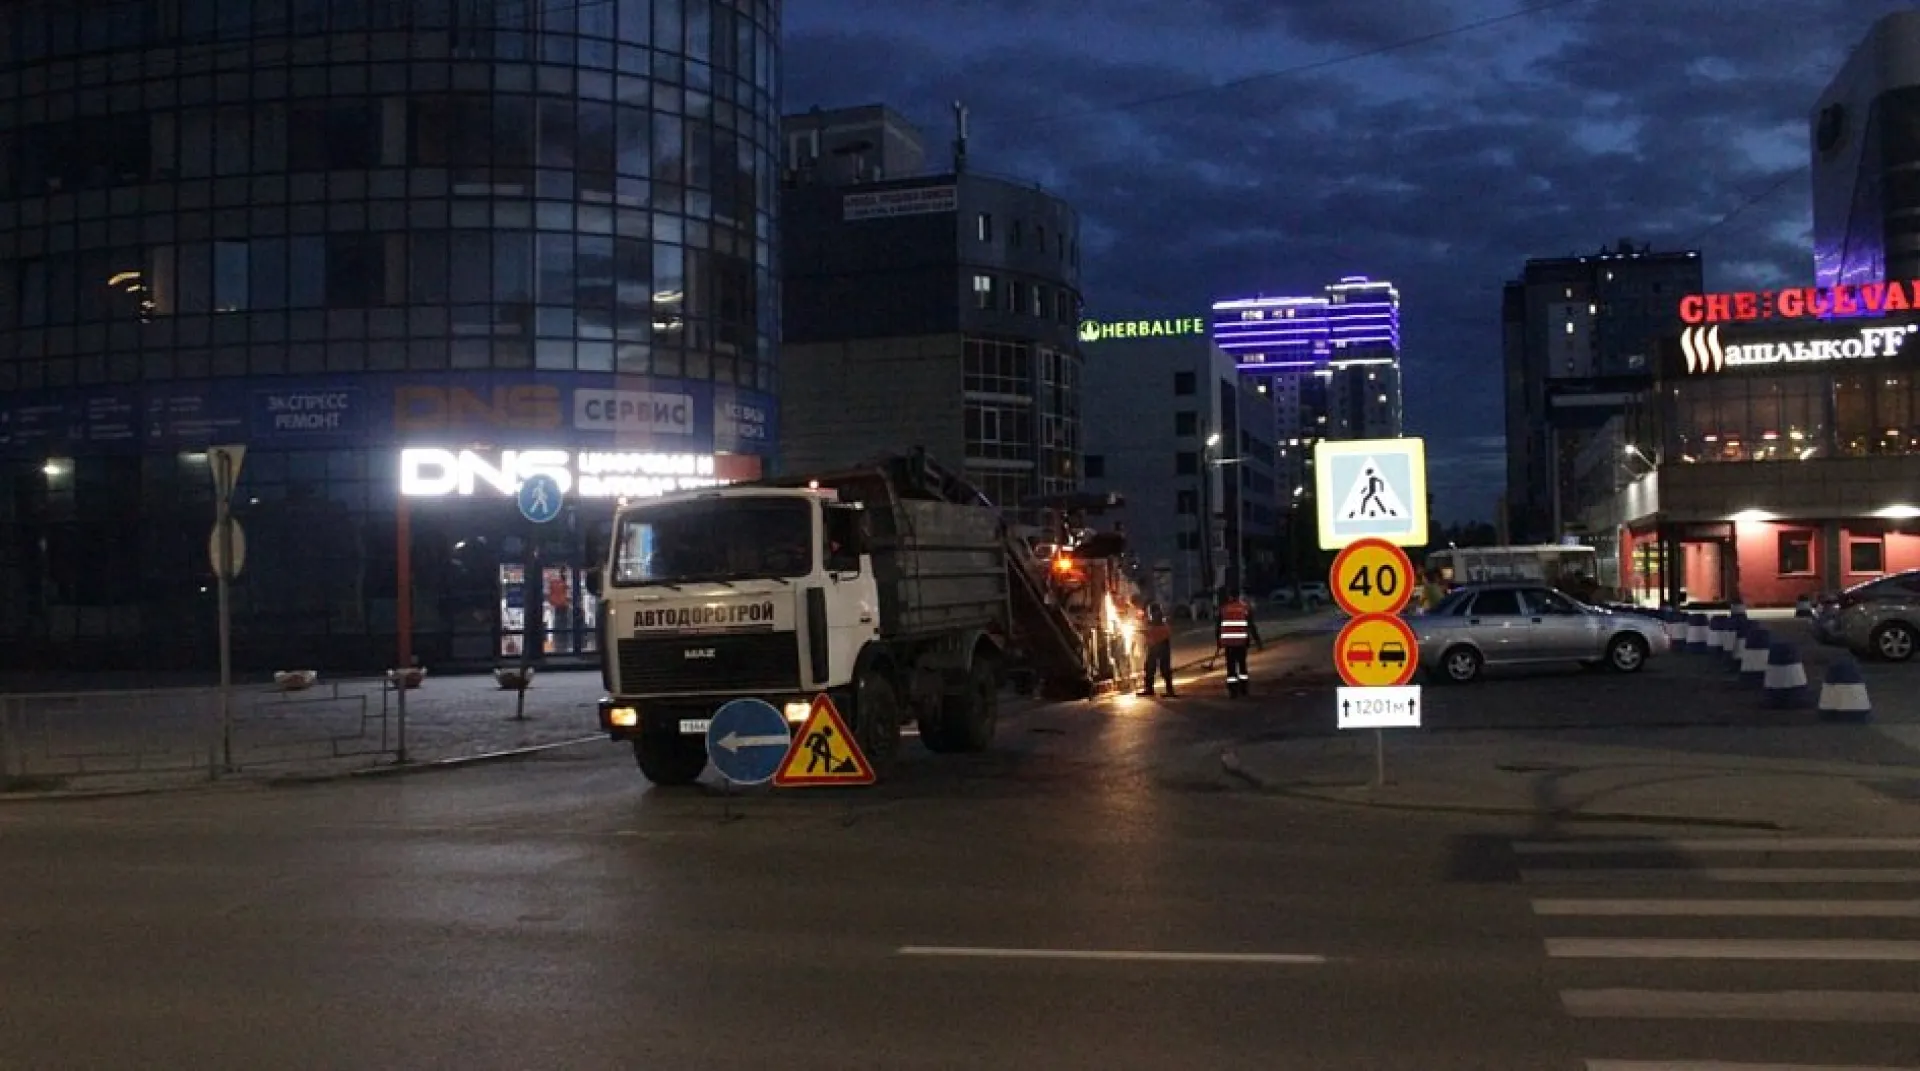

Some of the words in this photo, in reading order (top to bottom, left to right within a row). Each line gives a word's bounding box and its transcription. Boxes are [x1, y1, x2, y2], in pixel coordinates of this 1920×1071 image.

[1680, 291, 1757, 323] CHE
[1102, 318, 1204, 338] HERBALIFE
[267, 393, 348, 410] ЭКСПРЕСС
[395, 384, 562, 431] DNS
[584, 398, 687, 426] СЕРВИС
[275, 412, 340, 429] РЕМОНТ
[400, 447, 572, 495] DNS
[1348, 564, 1397, 597] 40
[634, 600, 774, 627] АВТОДОРСТРОЙ
